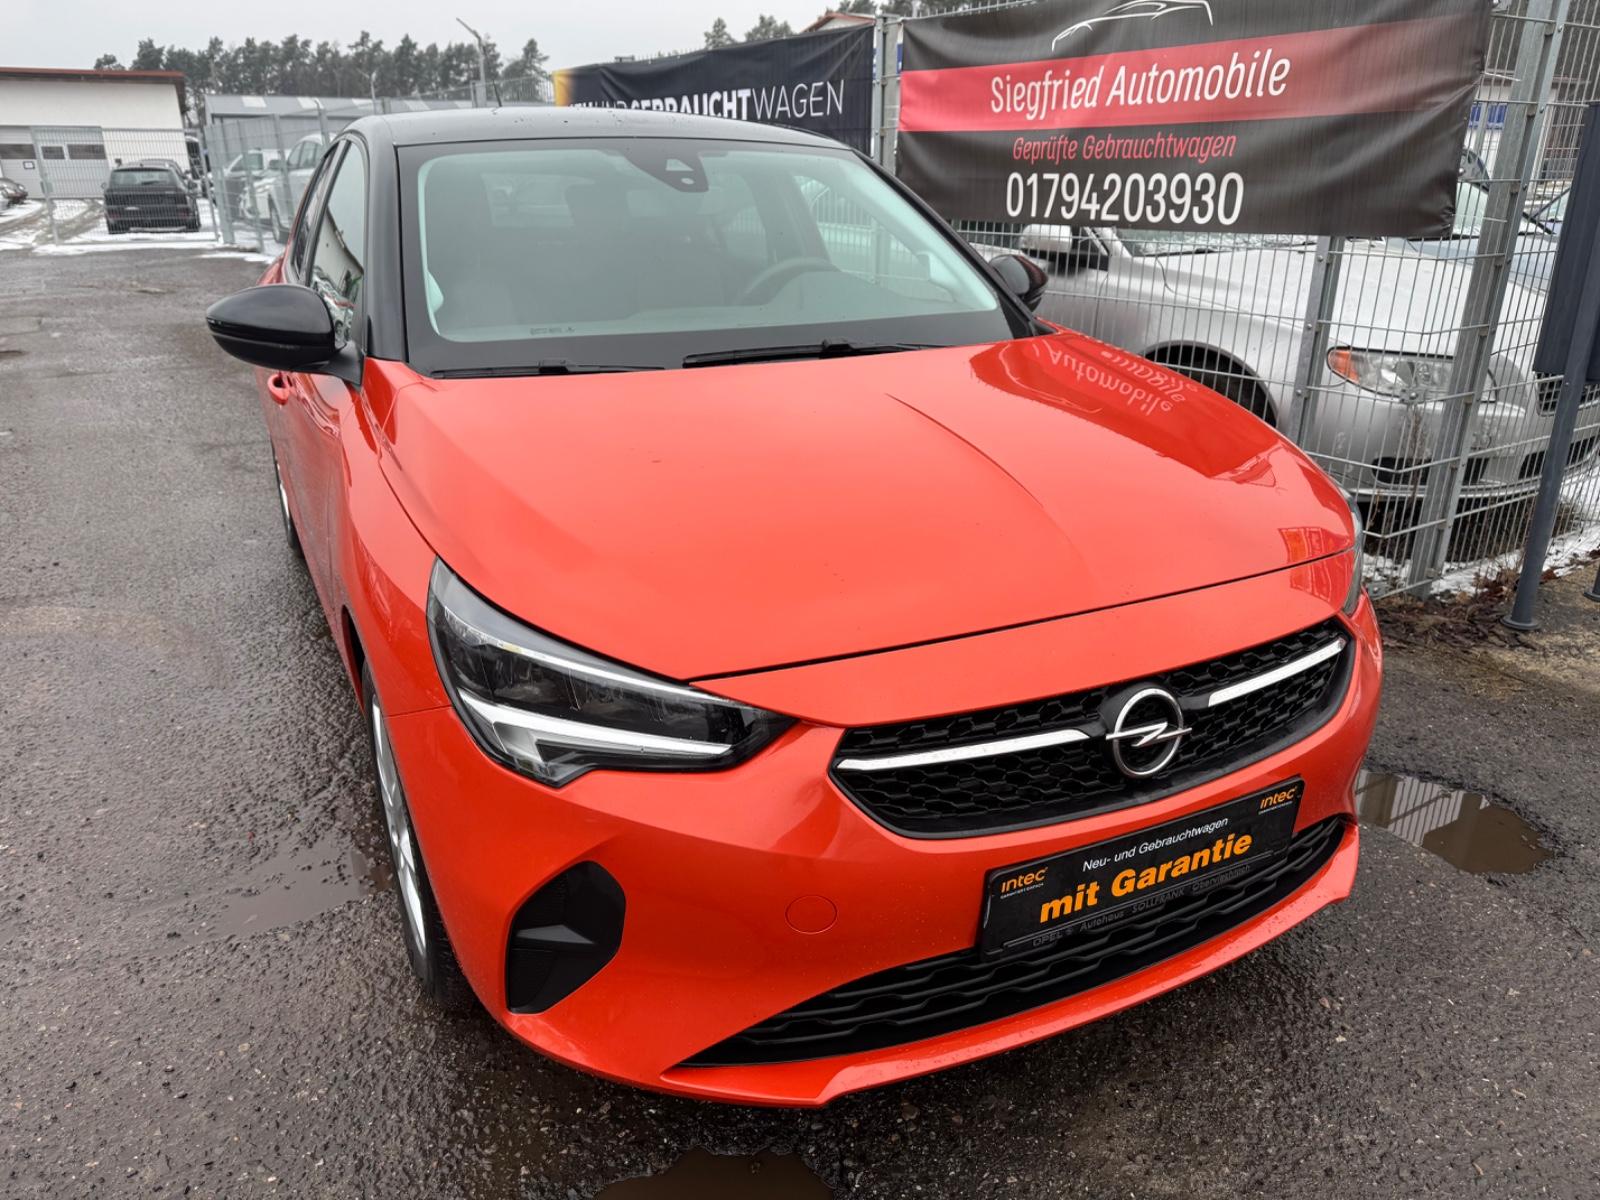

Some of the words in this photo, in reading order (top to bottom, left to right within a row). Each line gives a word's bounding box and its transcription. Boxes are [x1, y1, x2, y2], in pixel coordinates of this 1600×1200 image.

[991, 65, 1105, 121] Siegfried
[1105, 48, 1291, 107] Automobile
[1012, 134, 1078, 165] Geprüfte
[1082, 132, 1237, 164] Gebrauchtwagen
[1006, 172, 1244, 225] 01794203930
[1260, 787, 1297, 809] intec
[1082, 857, 1112, 873] Neu-
[1114, 846, 1137, 863] und
[1138, 817, 1229, 853] Gebrauchtwagen
[1001, 868, 1047, 893] intec
[1039, 880, 1100, 924] mit
[1110, 833, 1253, 898] Garantie
